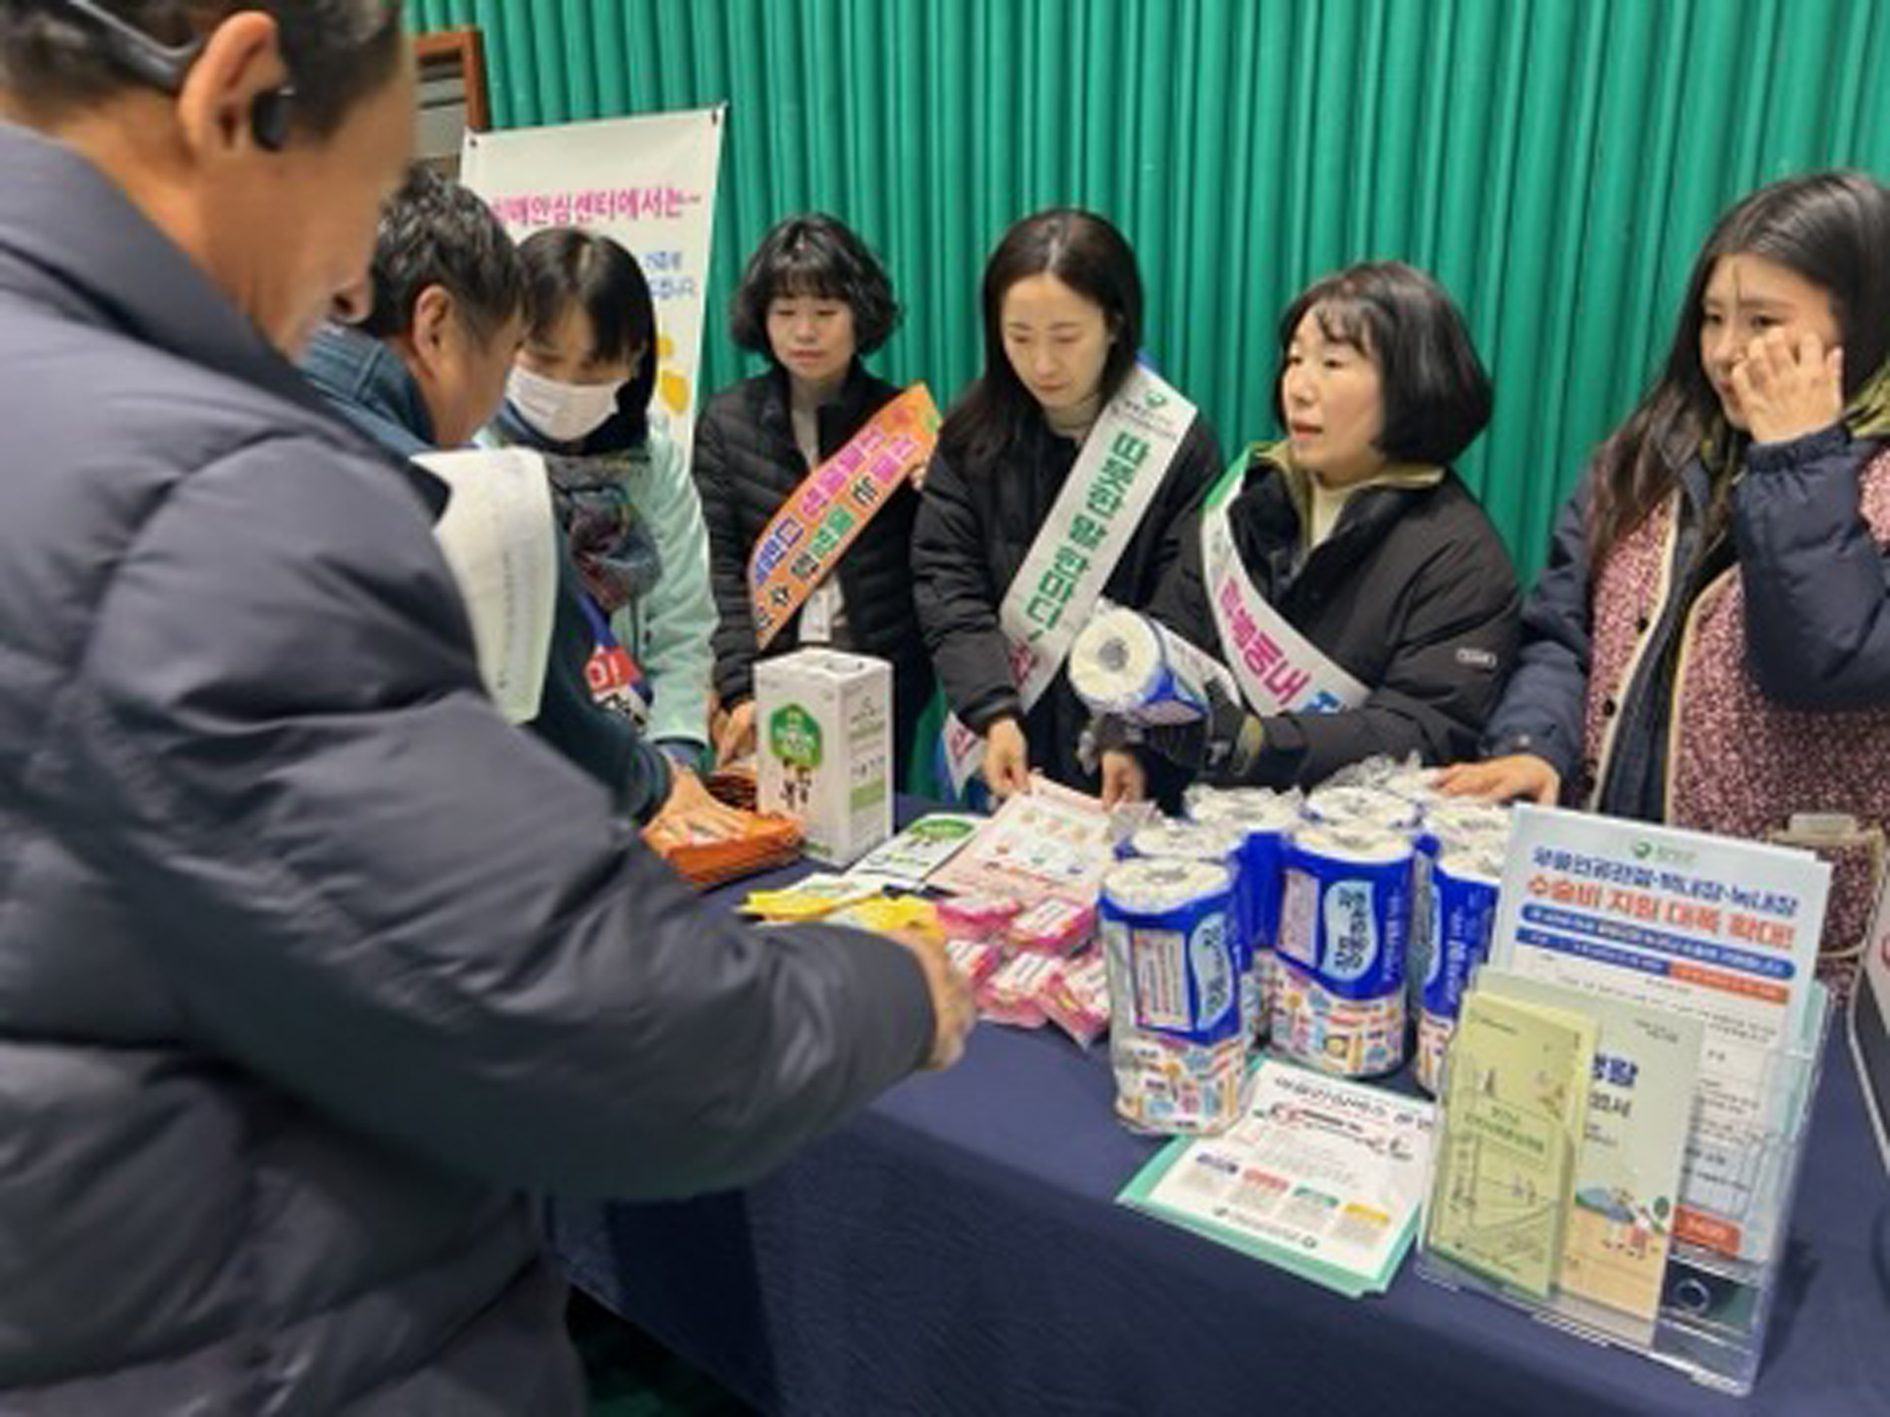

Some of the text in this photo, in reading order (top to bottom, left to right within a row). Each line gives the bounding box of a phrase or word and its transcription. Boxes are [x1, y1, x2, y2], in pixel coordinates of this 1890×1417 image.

[1085, 431, 1149, 519] 따뜻한
[1527, 874, 1600, 909] 수술비
[1607, 887, 1659, 922] 지원
